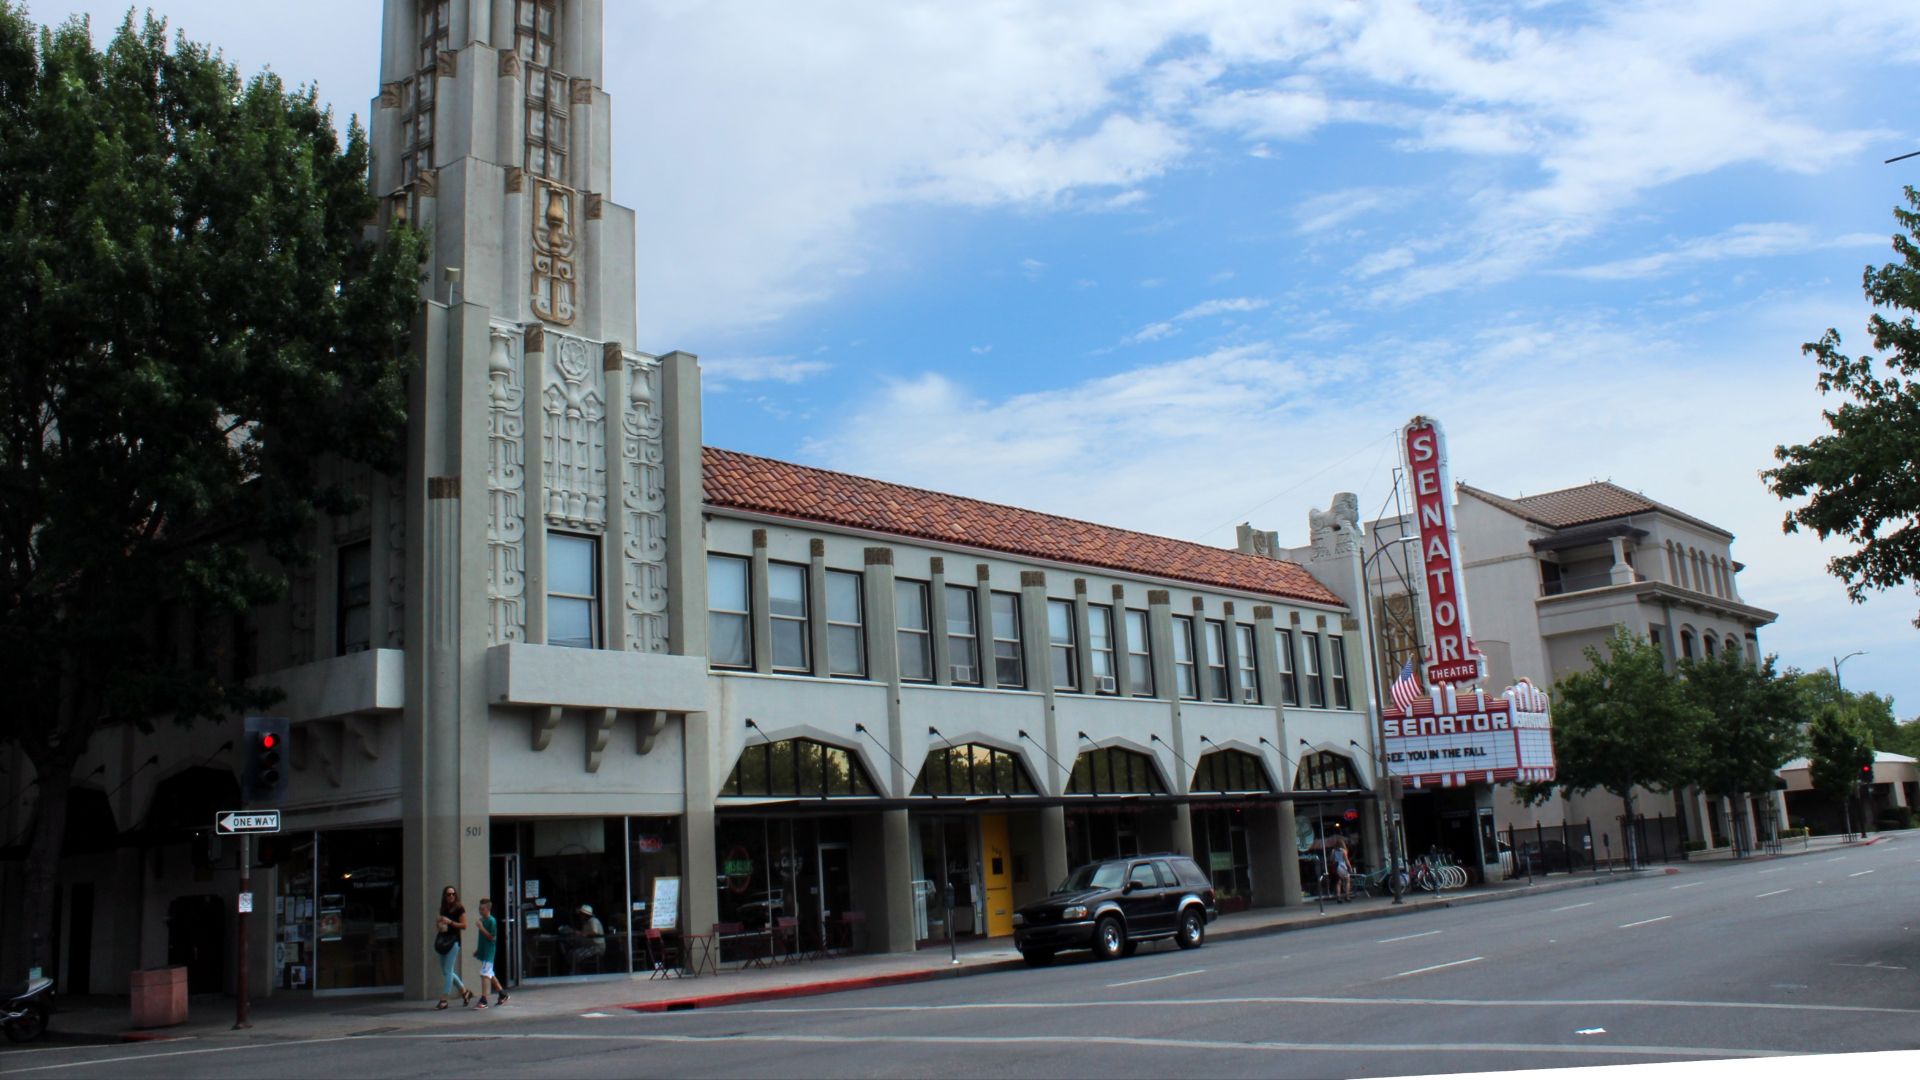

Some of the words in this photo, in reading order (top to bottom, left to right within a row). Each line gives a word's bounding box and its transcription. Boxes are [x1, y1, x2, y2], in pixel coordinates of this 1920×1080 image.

[1413, 435, 1460, 662] SENATOR
[1430, 664, 1475, 680] THEATRE
[1384, 712, 1509, 736] SENATOR
[1407, 750, 1427, 760] YOU
[1429, 749, 1439, 759] IN
[1442, 748, 1461, 758] THE
[1463, 747, 1487, 757] FALL
[233, 817, 252, 827] ONE
[255, 816, 275, 826] WAY
[465, 826, 481, 837] 501
